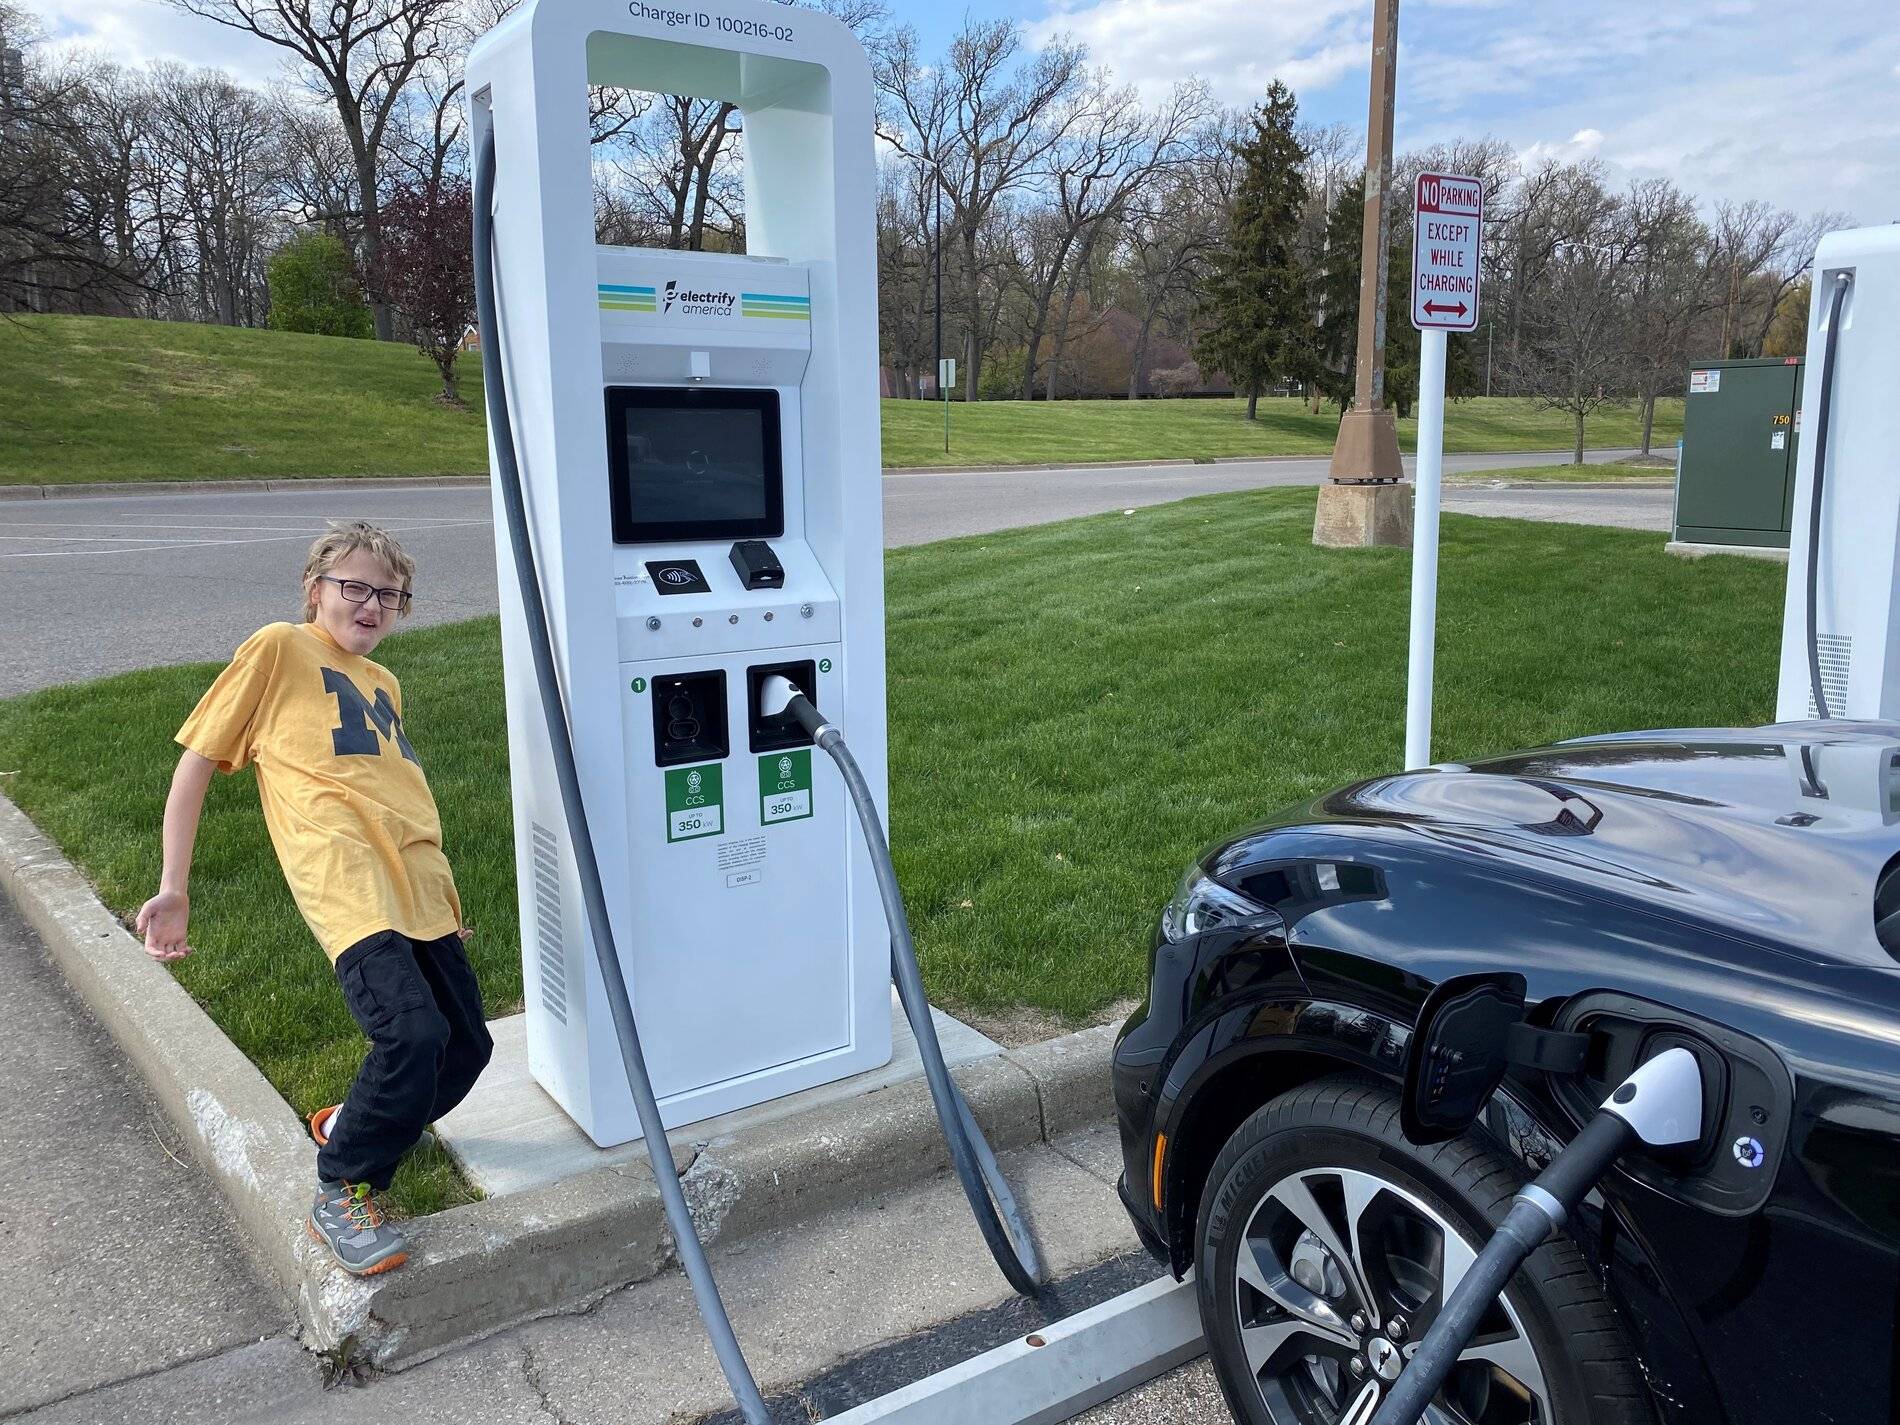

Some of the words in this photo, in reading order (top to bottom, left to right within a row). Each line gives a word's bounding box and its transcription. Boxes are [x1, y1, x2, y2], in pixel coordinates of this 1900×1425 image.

[629, 1, 691, 26] Charger
[695, 13, 710, 28] ID
[716, 16, 794, 42] 100216-02
[1421, 181, 1438, 207] NO
[1441, 186, 1478, 208] PARKING
[1428, 223, 1469, 243] EXCEPT
[1430, 249, 1463, 267] WHILE
[1420, 273, 1473, 293] CHARGING
[680, 290, 736, 306] electrify
[682, 304, 732, 316] america
[1773, 415, 1790, 425] 750
[320, 667, 420, 768] M
[778, 780, 795, 790] CCS
[685, 795, 705, 806] CCS
[771, 803, 792, 815] 350
[679, 819, 701, 832] 350
